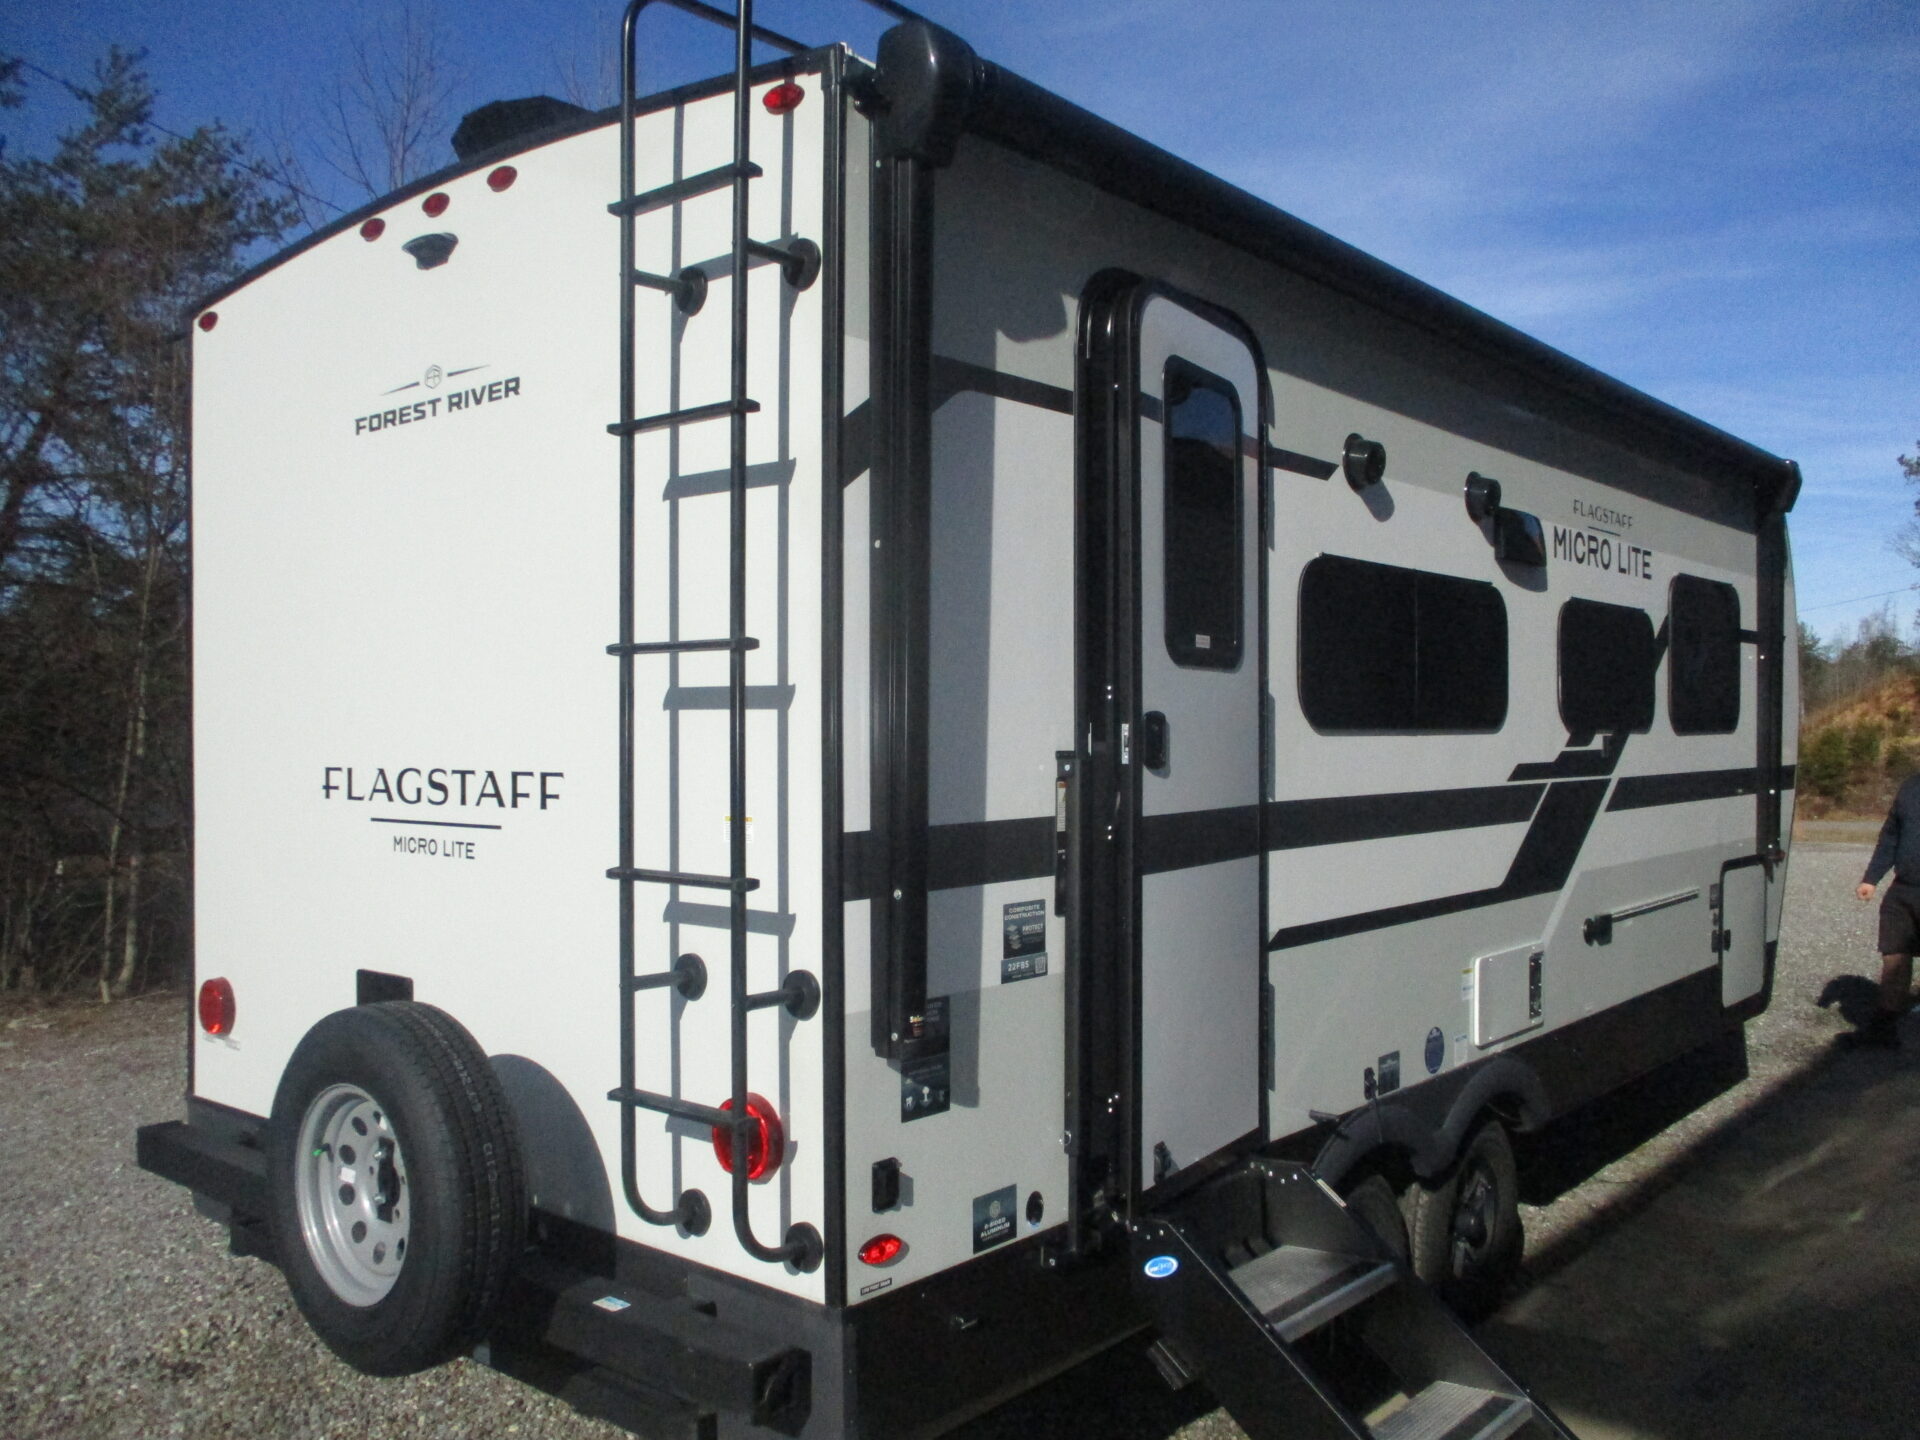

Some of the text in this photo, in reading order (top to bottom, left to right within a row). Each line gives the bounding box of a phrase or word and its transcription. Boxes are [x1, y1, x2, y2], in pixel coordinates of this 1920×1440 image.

[354, 376, 521, 436] FOREST RIVER
[1573, 499, 1632, 528] FLAGSTAFF
[1553, 525, 1652, 580] MICRO LITE
[322, 767, 565, 810] FLAGSTAFF
[393, 835, 476, 860] MICRO LITE
